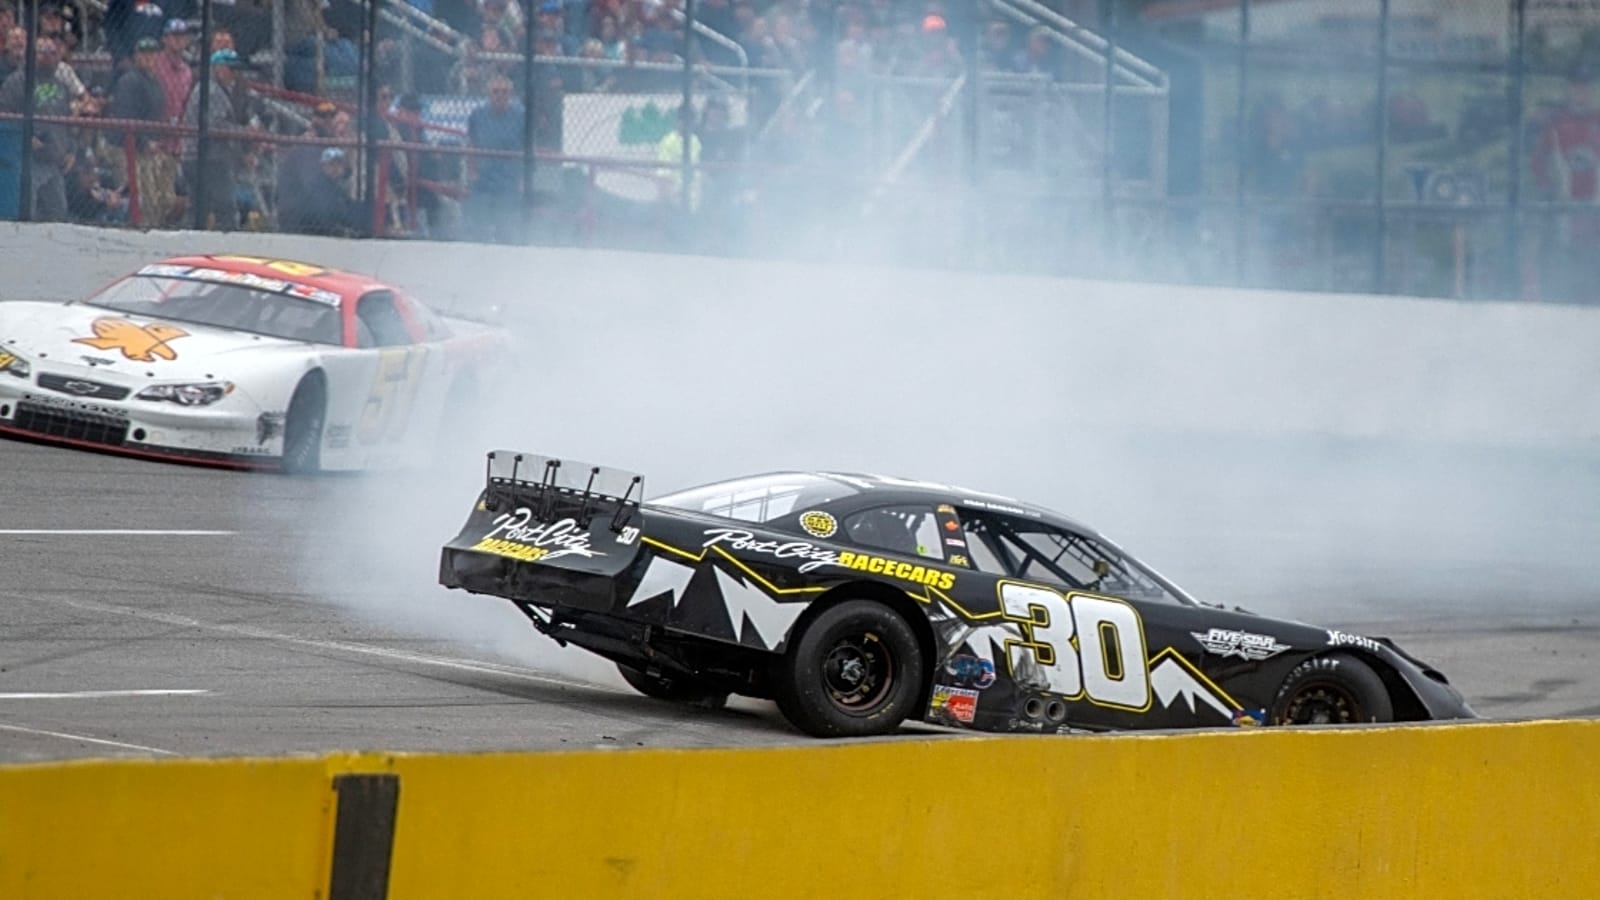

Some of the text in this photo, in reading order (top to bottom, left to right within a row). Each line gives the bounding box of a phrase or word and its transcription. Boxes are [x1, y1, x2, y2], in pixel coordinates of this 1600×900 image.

[482, 508, 608, 561] Port City
[616, 526, 640, 545] 30
[702, 528, 776, 553] Port
[773, 542, 846, 573] City
[838, 551, 956, 590] RACECARS
[997, 579, 1152, 712] 30
[1207, 628, 1241, 645] FIVE
[1241, 633, 1276, 649] STAR
[1326, 629, 1382, 651] Hoosier
